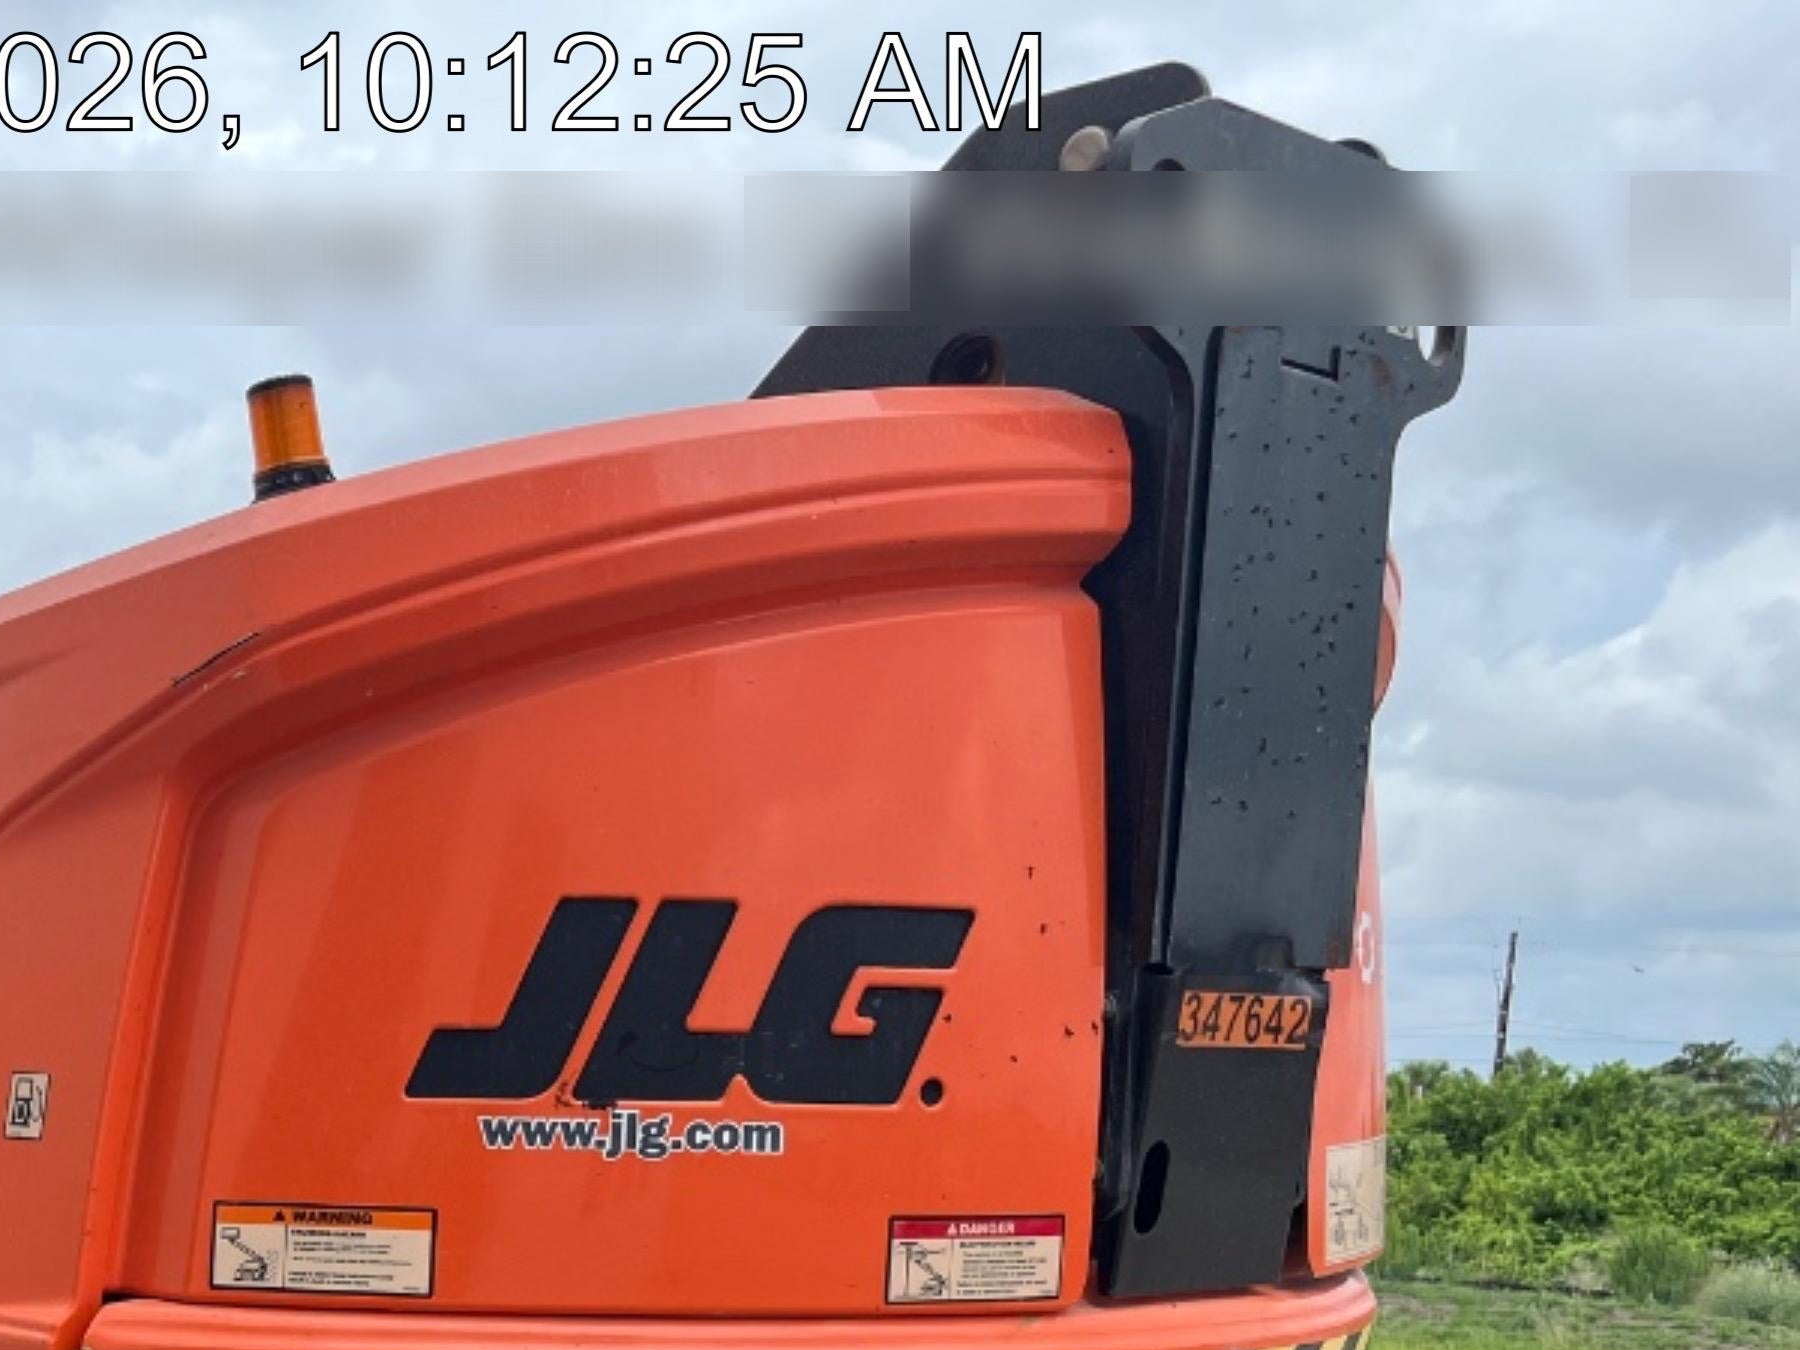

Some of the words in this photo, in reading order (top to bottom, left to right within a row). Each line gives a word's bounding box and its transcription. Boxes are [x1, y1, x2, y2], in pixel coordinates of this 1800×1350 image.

[404, 896, 976, 1107] JLG
[1179, 994, 1309, 1045] 347642
[478, 1109, 784, 1160] www.jlg.com
[292, 1209, 374, 1226] WARNING
[959, 1221, 1016, 1235] DANGER
